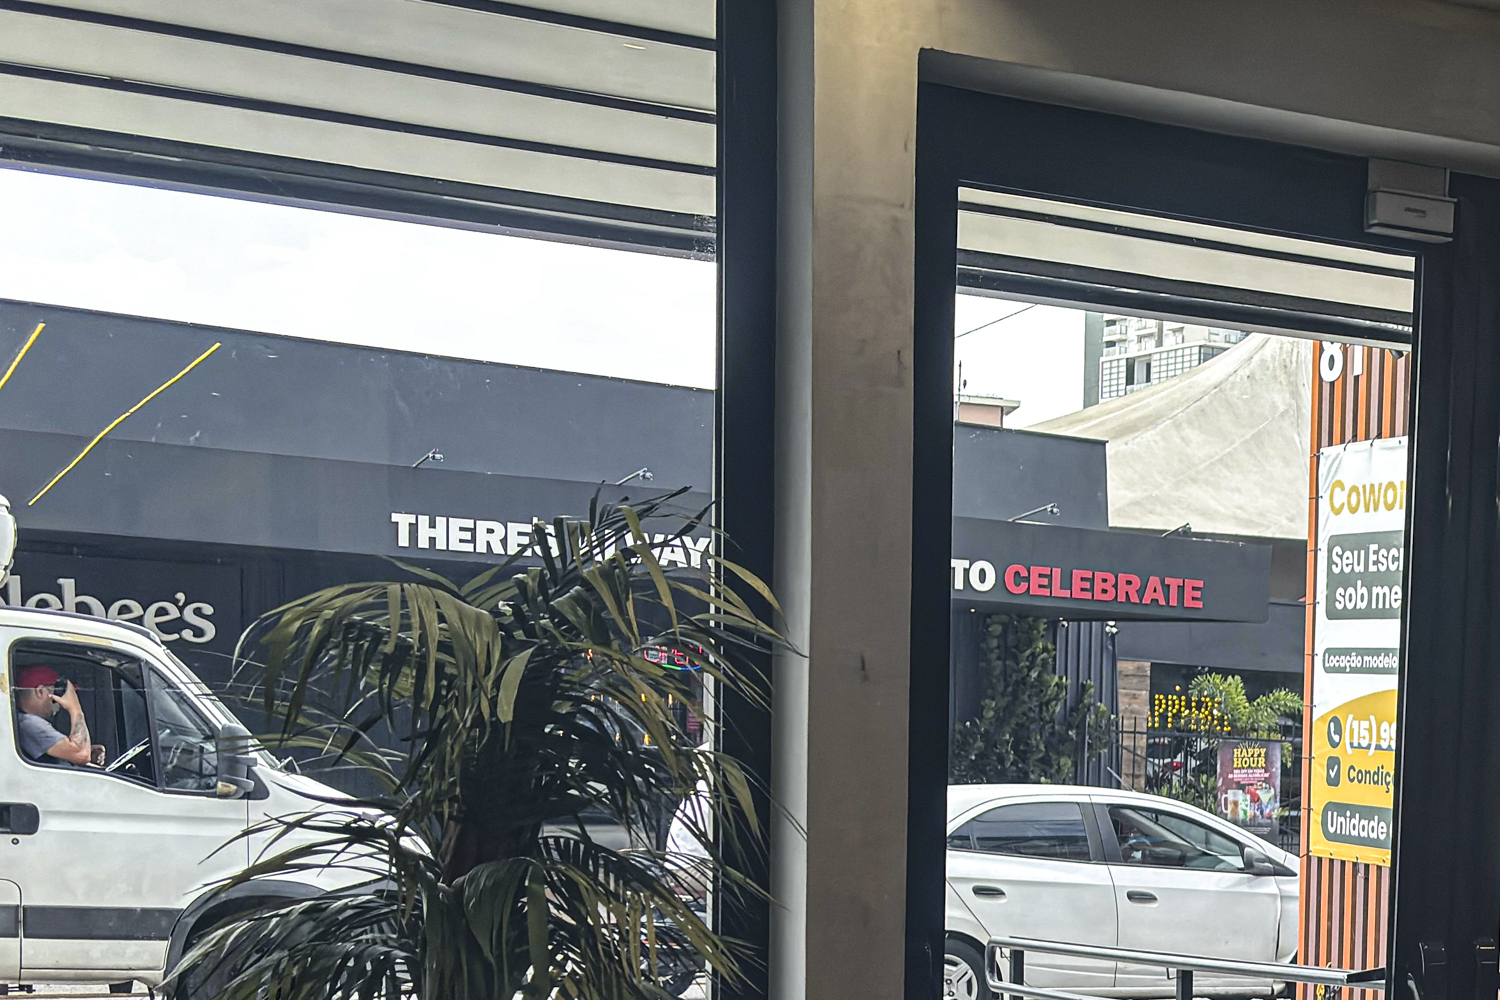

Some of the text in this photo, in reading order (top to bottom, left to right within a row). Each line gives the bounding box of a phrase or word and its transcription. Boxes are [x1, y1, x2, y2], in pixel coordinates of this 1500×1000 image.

[1332, 545, 1365, 575] Seu
[951, 558, 1204, 609] TO CELEBRATE
[1335, 579, 1369, 610] sob
[1325, 651, 1398, 673] Locação modelo
[1345, 714, 1377, 756] (15)
[1233, 748, 1267, 758] HAPPY
[1233, 757, 1266, 769] HOUR
[1327, 810, 1387, 841] Unidade
